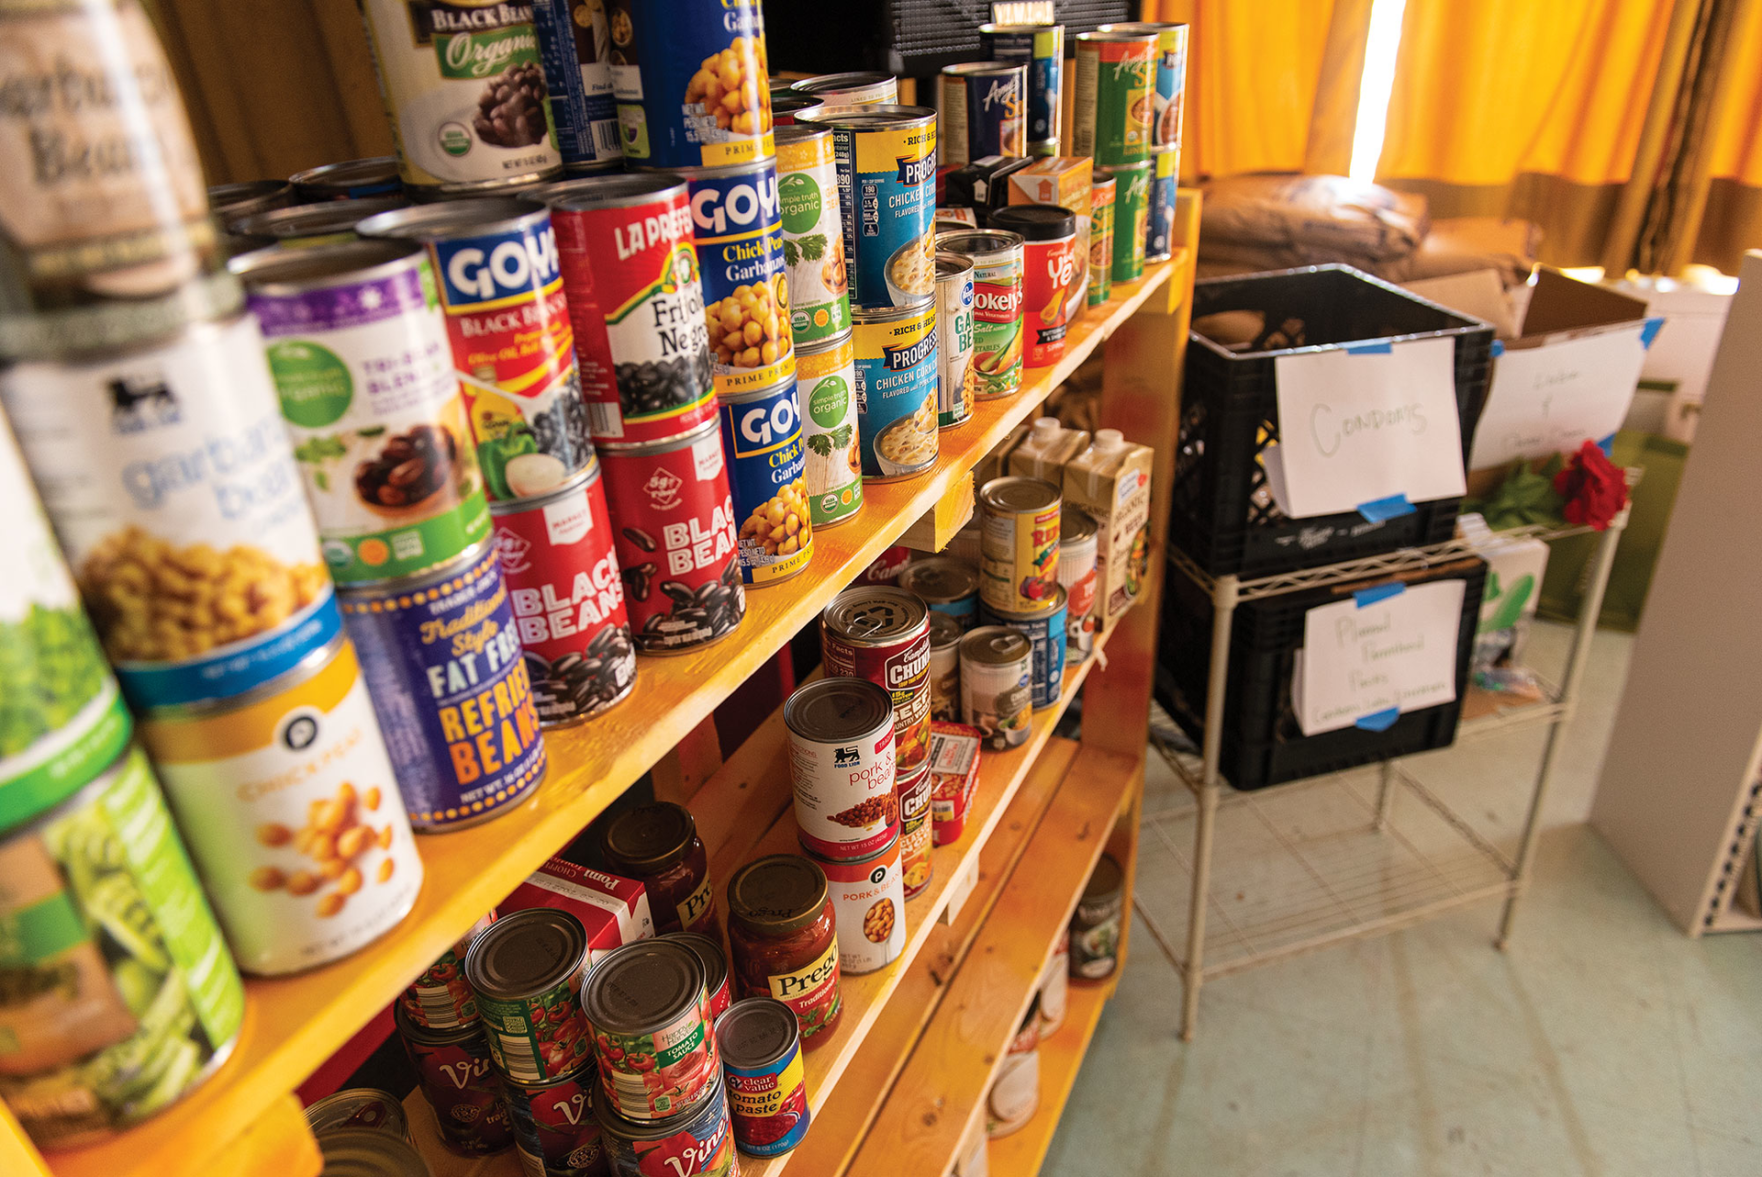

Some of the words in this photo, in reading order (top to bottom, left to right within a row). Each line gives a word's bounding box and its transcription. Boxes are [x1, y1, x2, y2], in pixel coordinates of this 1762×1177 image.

[432, 9, 498, 31] BLACK
[907, 133, 927, 146] RICH
[801, 192, 819, 202] truth
[614, 221, 646, 261] LA
[723, 240, 765, 263] Chick
[1048, 255, 1073, 290] Ye
[974, 285, 1023, 313] okely's
[460, 309, 522, 338] BLACK
[894, 323, 916, 337] RICH
[916, 322, 921, 330] &
[974, 323, 993, 334] Salt
[958, 328, 973, 353] BE
[726, 372, 764, 388] PRIME
[876, 371, 915, 391] CHICKEN
[916, 363, 931, 380] CORN
[882, 386, 910, 400] FLAVORED
[813, 396, 847, 414] organic
[769, 443, 799, 469] Chick
[772, 555, 801, 574] PRIME
[512, 544, 621, 619] BLACK
[517, 570, 624, 645] BEANS
[426, 651, 479, 699] FAT
[894, 716, 914, 731] UNTRY
[448, 690, 540, 786] BEANS
[848, 761, 884, 787] pork
[885, 751, 892, 766] &
[849, 760, 861, 768] LION
[843, 890, 872, 901] PORK
[873, 887, 880, 896] &
[778, 945, 837, 997] Prego
[799, 976, 836, 1009] Traditional
[666, 1031, 698, 1057] TOMATO
[673, 1041, 695, 1060] SAUCE
[729, 1076, 743, 1089] CV
[743, 1075, 772, 1086] clear
[744, 1081, 775, 1092] value
[728, 1089, 782, 1104] tomato
[735, 1103, 778, 1115] paste
